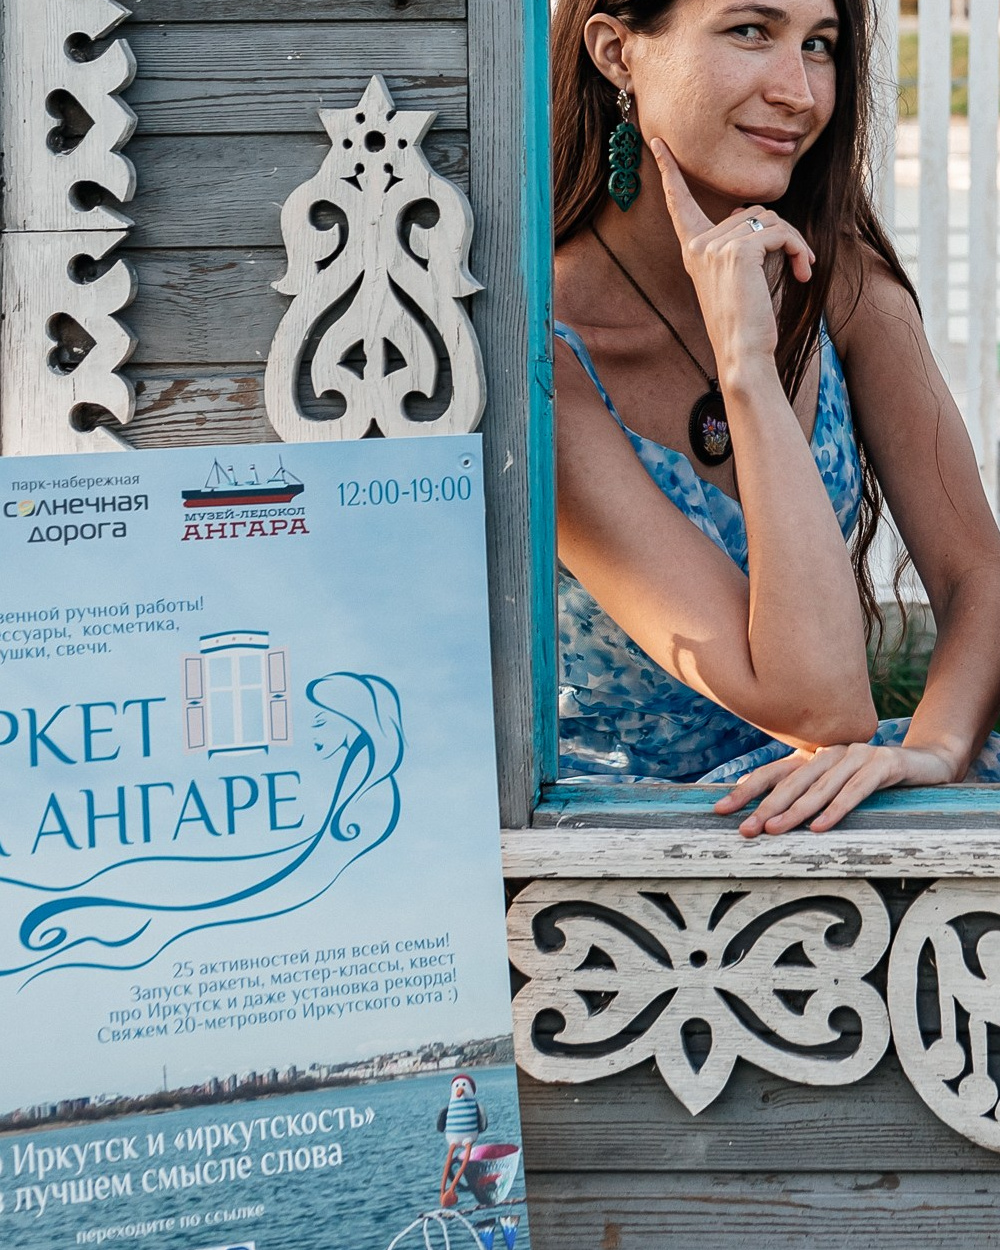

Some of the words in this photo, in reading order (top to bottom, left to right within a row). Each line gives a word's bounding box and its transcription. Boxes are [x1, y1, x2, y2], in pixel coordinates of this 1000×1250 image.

[12, 474, 140, 493] парк-набережная
[337, 475, 472, 507] 12:00-19:00
[181, 518, 310, 541] АНГАРА
[184, 507, 306, 522] МУЗЕЙ-ЛЕДОКОЛ
[27, 521, 127, 546] дорога
[65, 602, 130, 623] ручной
[136, 596, 204, 618] работы!
[0, 627, 72, 645] ссуары,
[83, 619, 180, 637] косметика,
[56, 642, 112, 657] свечи.
[31, 770, 305, 855] АНГАРЕ
[173, 960, 194, 979] 25
[200, 950, 309, 975] активностей
[315, 947, 346, 964] для
[352, 941, 390, 958] всей
[395, 932, 450, 952] семьи!
[130, 984, 192, 1002] Запуск
[198, 975, 265, 997] ракеты,
[270, 959, 404, 985] мастер-классы,
[410, 953, 456, 969] квест
[109, 1008, 142, 1026] про
[148, 999, 221, 1020] Иркутск
[227, 997, 237, 1009] и
[243, 990, 286, 1009] даже
[292, 980, 379, 1005] установка
[385, 968, 457, 993] рекорда!
[97, 1024, 168, 1043] Свяжем
[174, 1008, 296, 1034] 20-метрового
[303, 995, 400, 1020] Иркутского
[407, 990, 442, 1006] кота
[12, 1136, 139, 1180] Иркутск
[146, 1132, 165, 1156] и
[174, 1106, 375, 1156] «иркутскость»
[14, 1172, 133, 1218] лучшем
[142, 1155, 252, 1193] смысле
[261, 1142, 343, 1176] слова
[76, 1217, 175, 1244] переходите
[180, 1214, 199, 1229] по
[204, 1204, 265, 1225] ссылке
